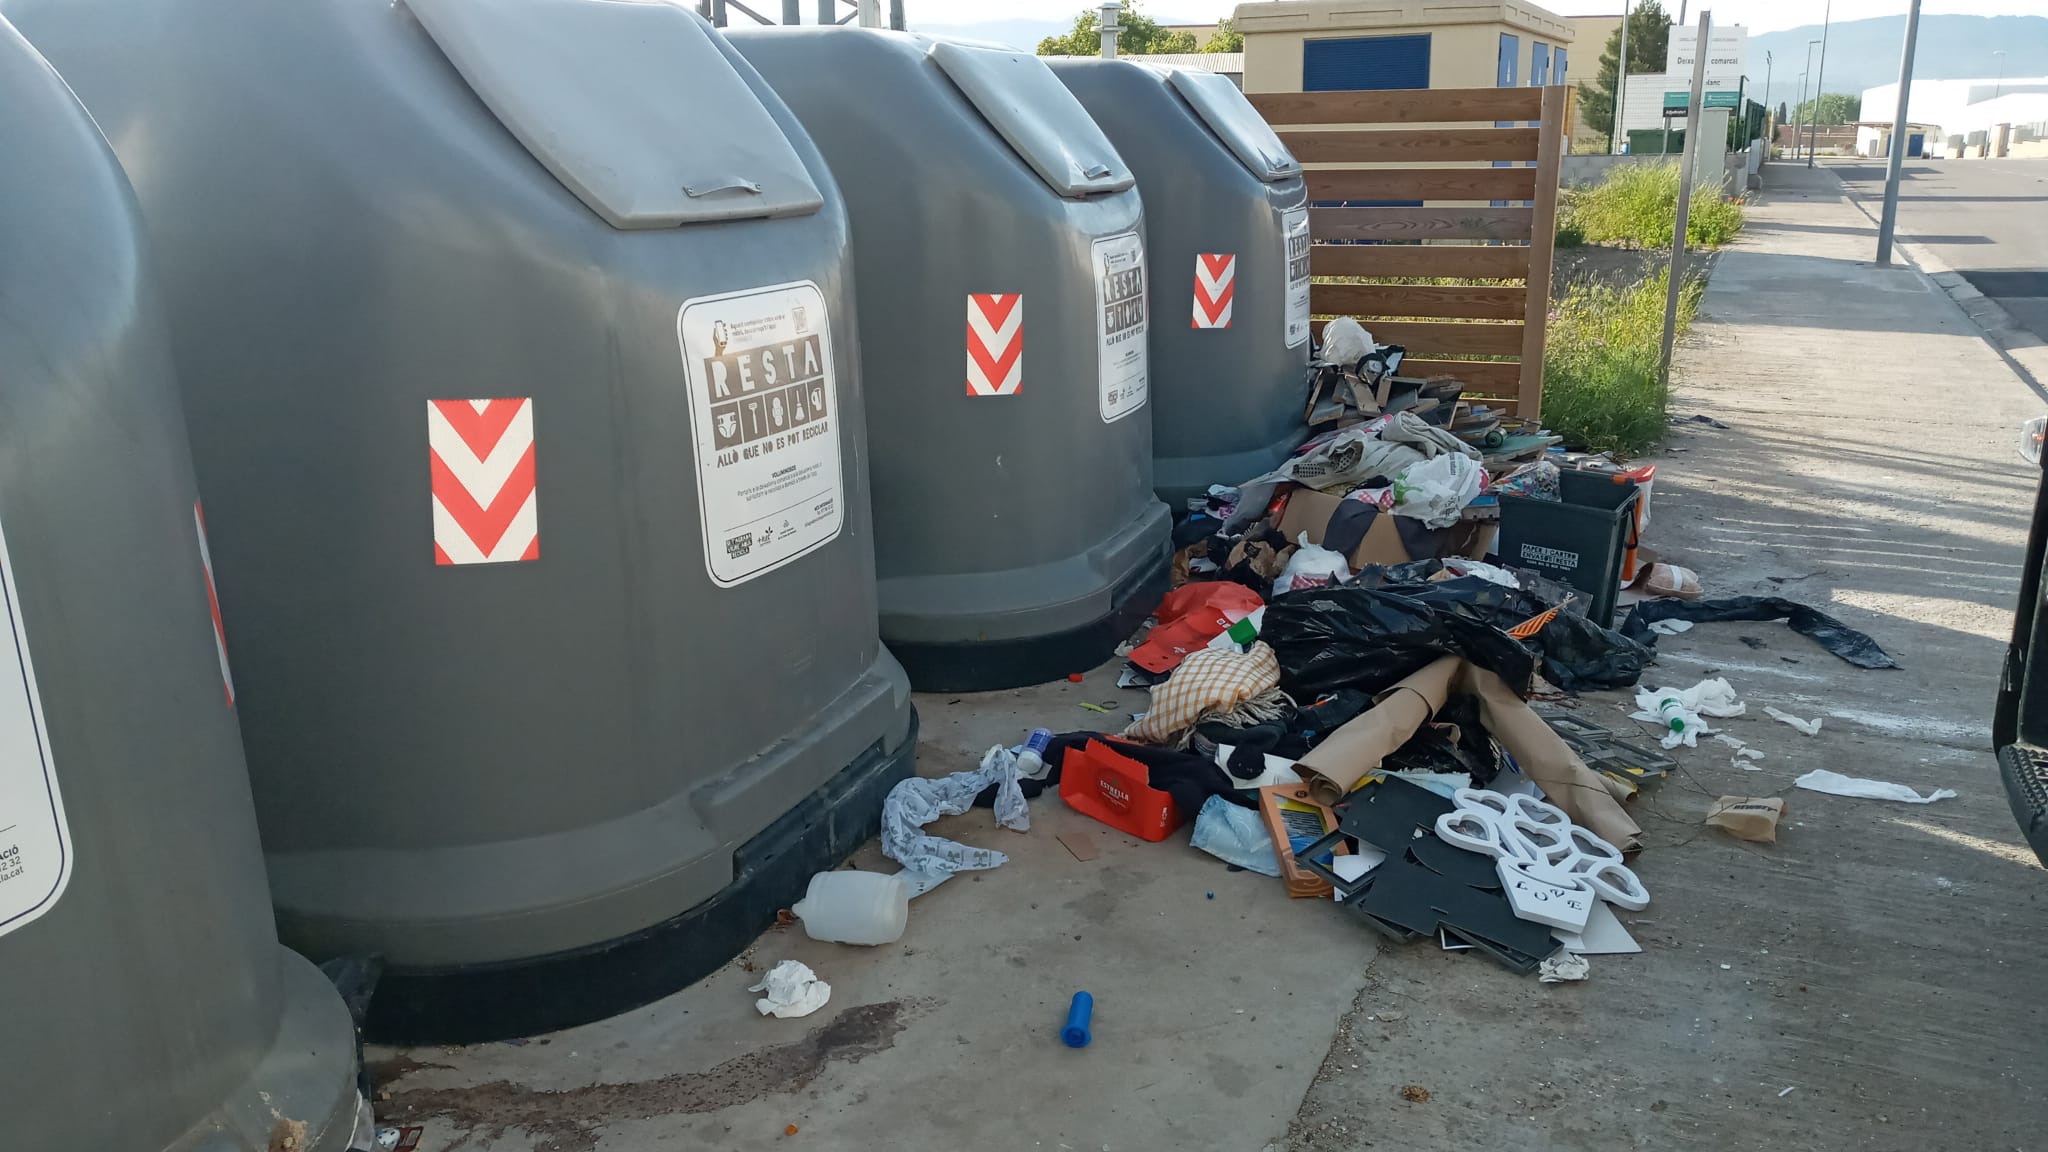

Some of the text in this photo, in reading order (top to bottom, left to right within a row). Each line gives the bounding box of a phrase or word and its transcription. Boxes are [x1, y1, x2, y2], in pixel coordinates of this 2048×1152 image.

[1711, 57, 1738, 65] comarcal
[1104, 270, 1142, 304] RESTA
[711, 340, 819, 398] RESTA
[717, 421, 828, 468] ALLÒ QUE NO ES POT RECICLAR
[1522, 544, 1543, 555] PAPER
[1522, 551, 1552, 563] ENVASOS
[1555, 557, 1577, 568] RESTA
[1100, 780, 1129, 801] ESTRELLA
[9, 856, 21, 867] 32
[1516, 881, 1583, 911] LOVE
